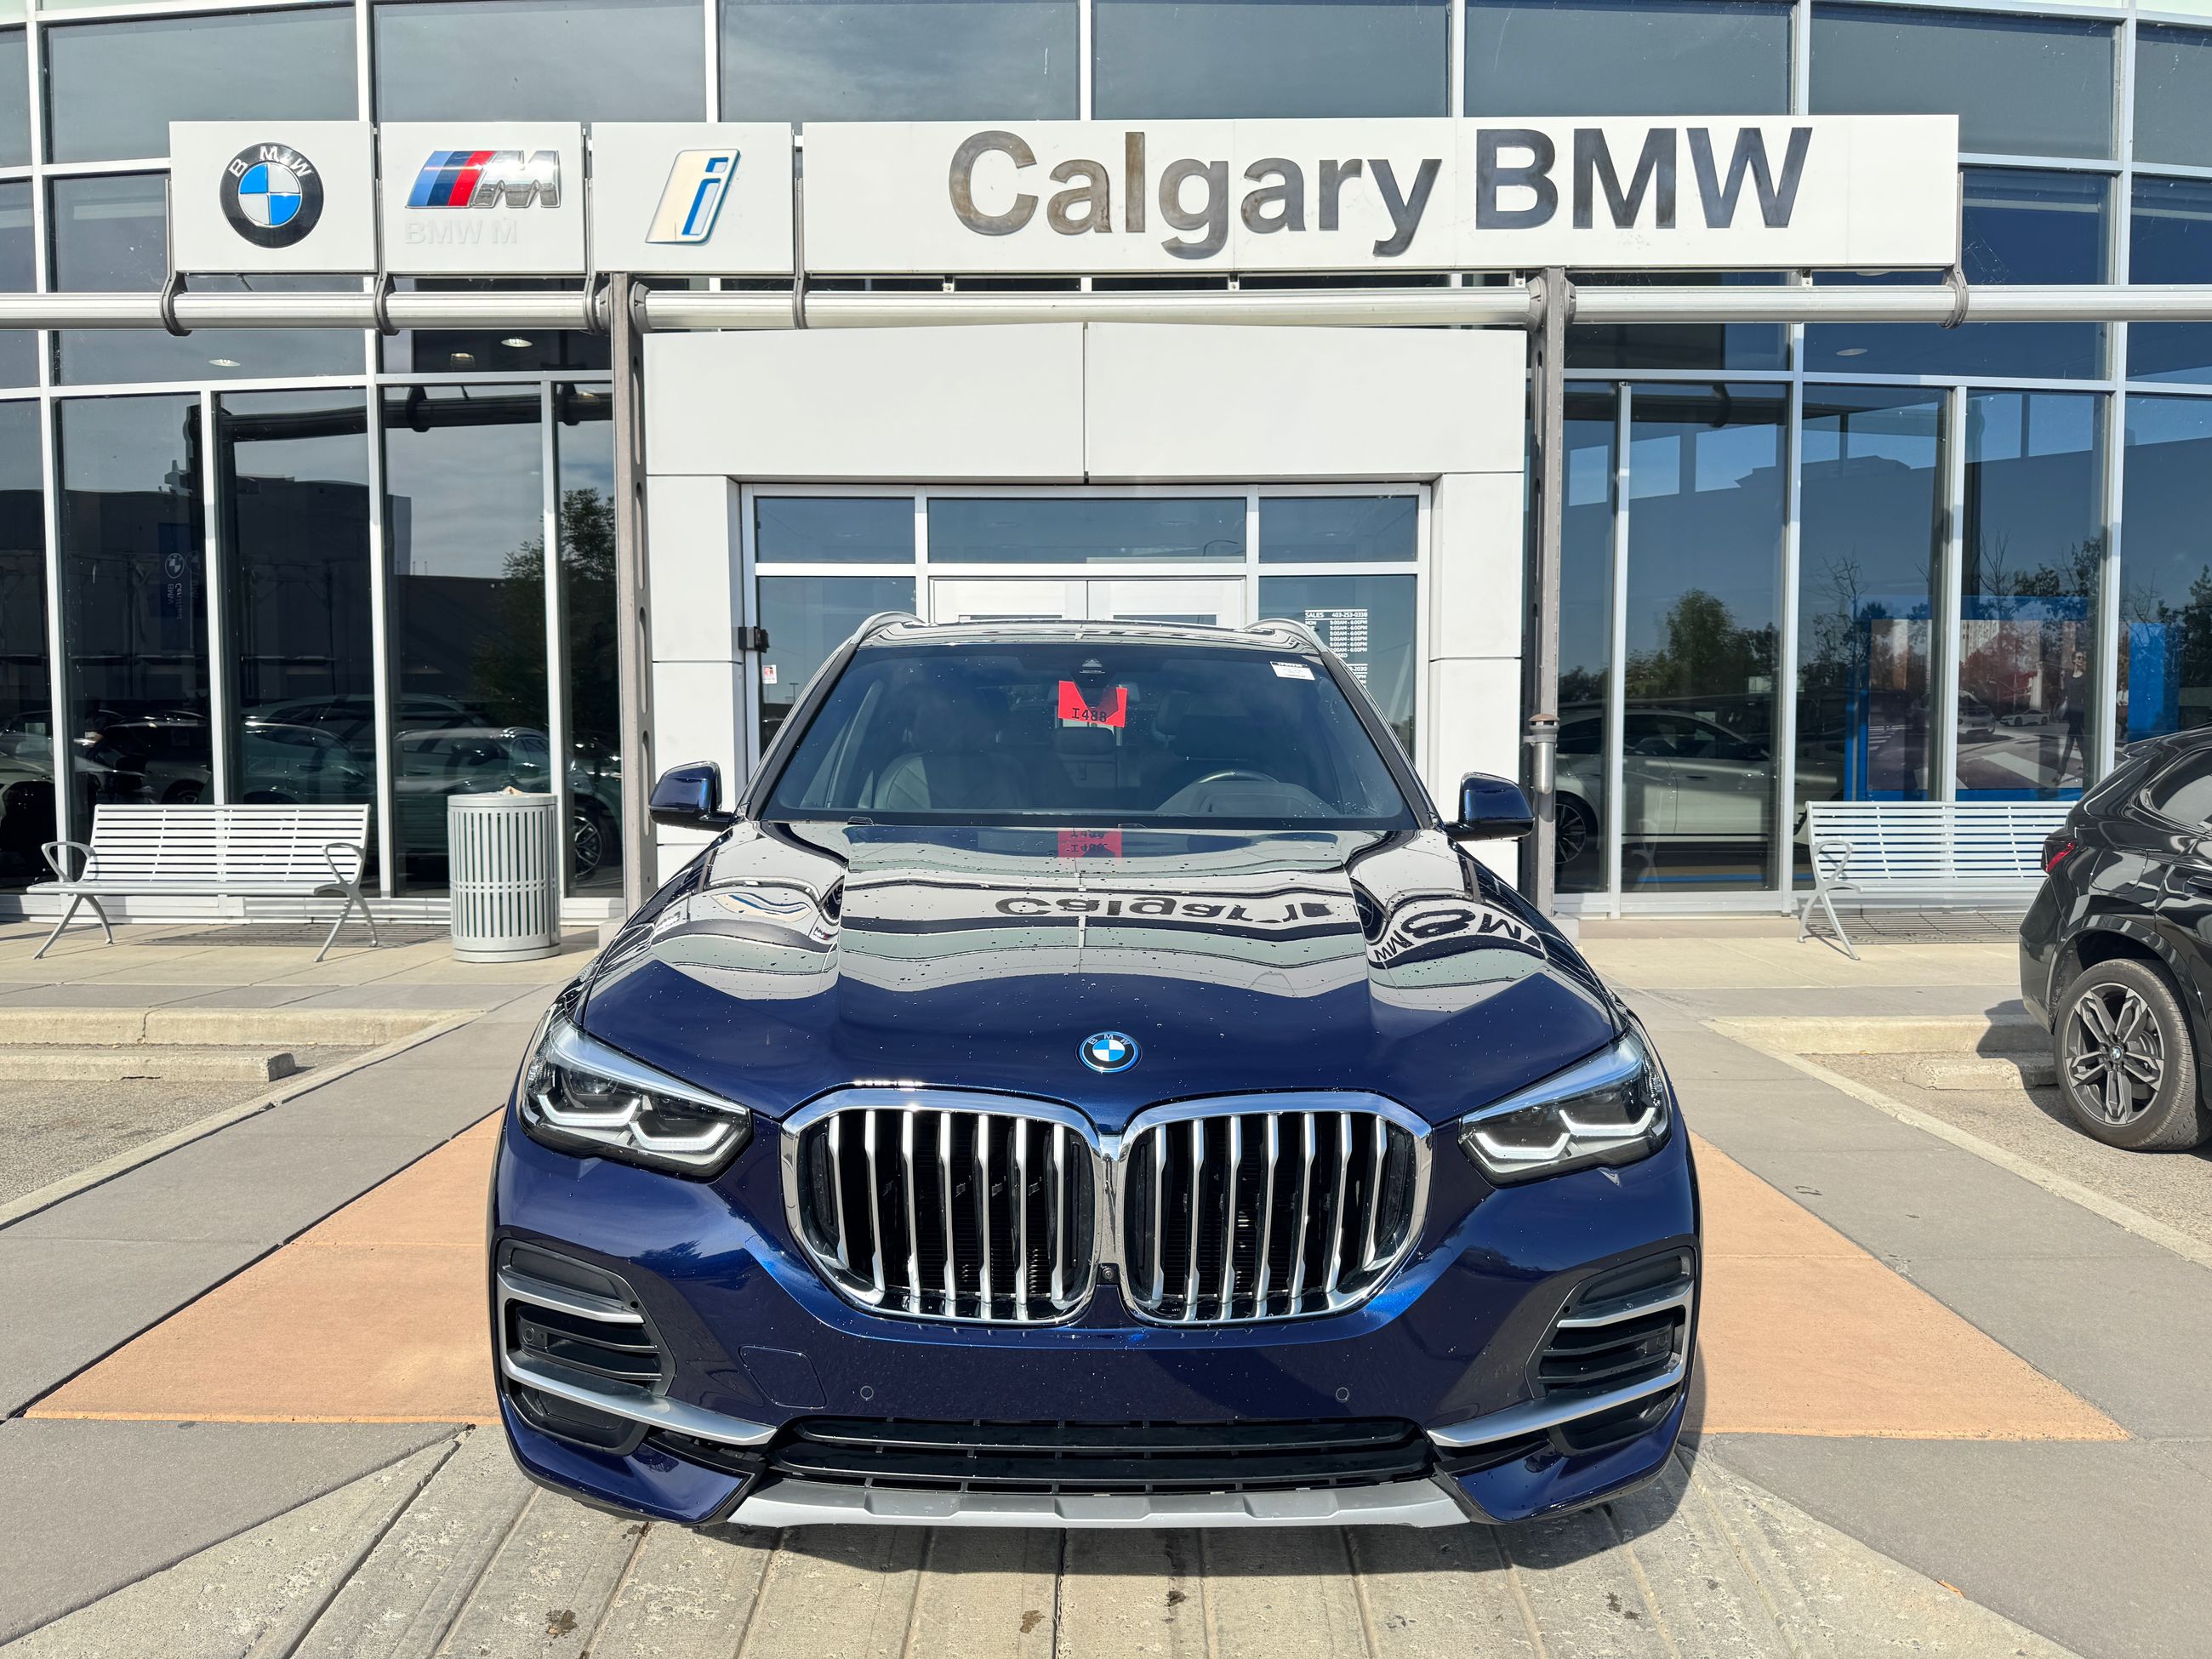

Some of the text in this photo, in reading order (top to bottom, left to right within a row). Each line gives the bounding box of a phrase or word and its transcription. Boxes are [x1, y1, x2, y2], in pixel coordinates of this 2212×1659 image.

[228, 145, 313, 178] BMW
[949, 128, 1813, 259] Calgary BMW
[405, 219, 517, 244] BMW M
[1088, 1034, 1131, 1045] BMW
